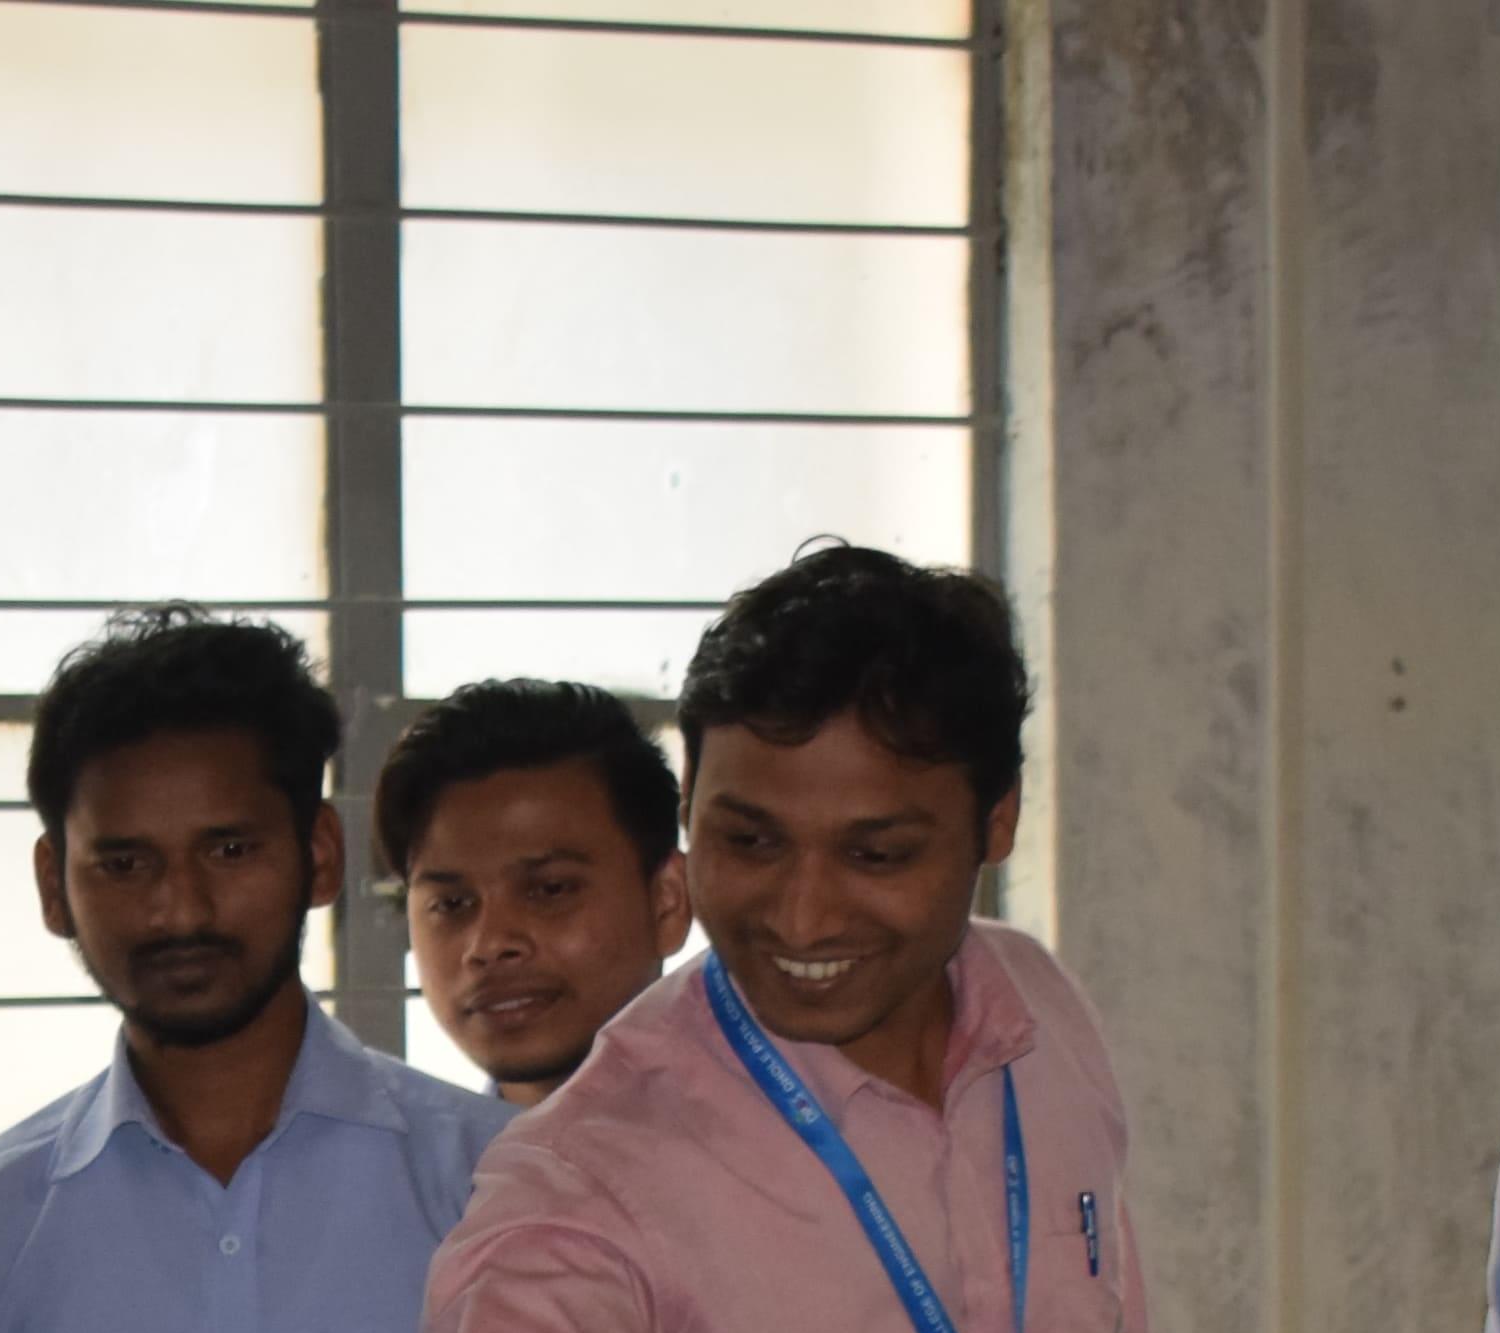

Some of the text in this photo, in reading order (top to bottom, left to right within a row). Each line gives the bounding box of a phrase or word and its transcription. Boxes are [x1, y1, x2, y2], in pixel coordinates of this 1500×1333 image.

[758, 1048, 796, 1095] DHOLE
[860, 1189, 916, 1277] ENGINEERING
[908, 1275, 926, 1297] OF
